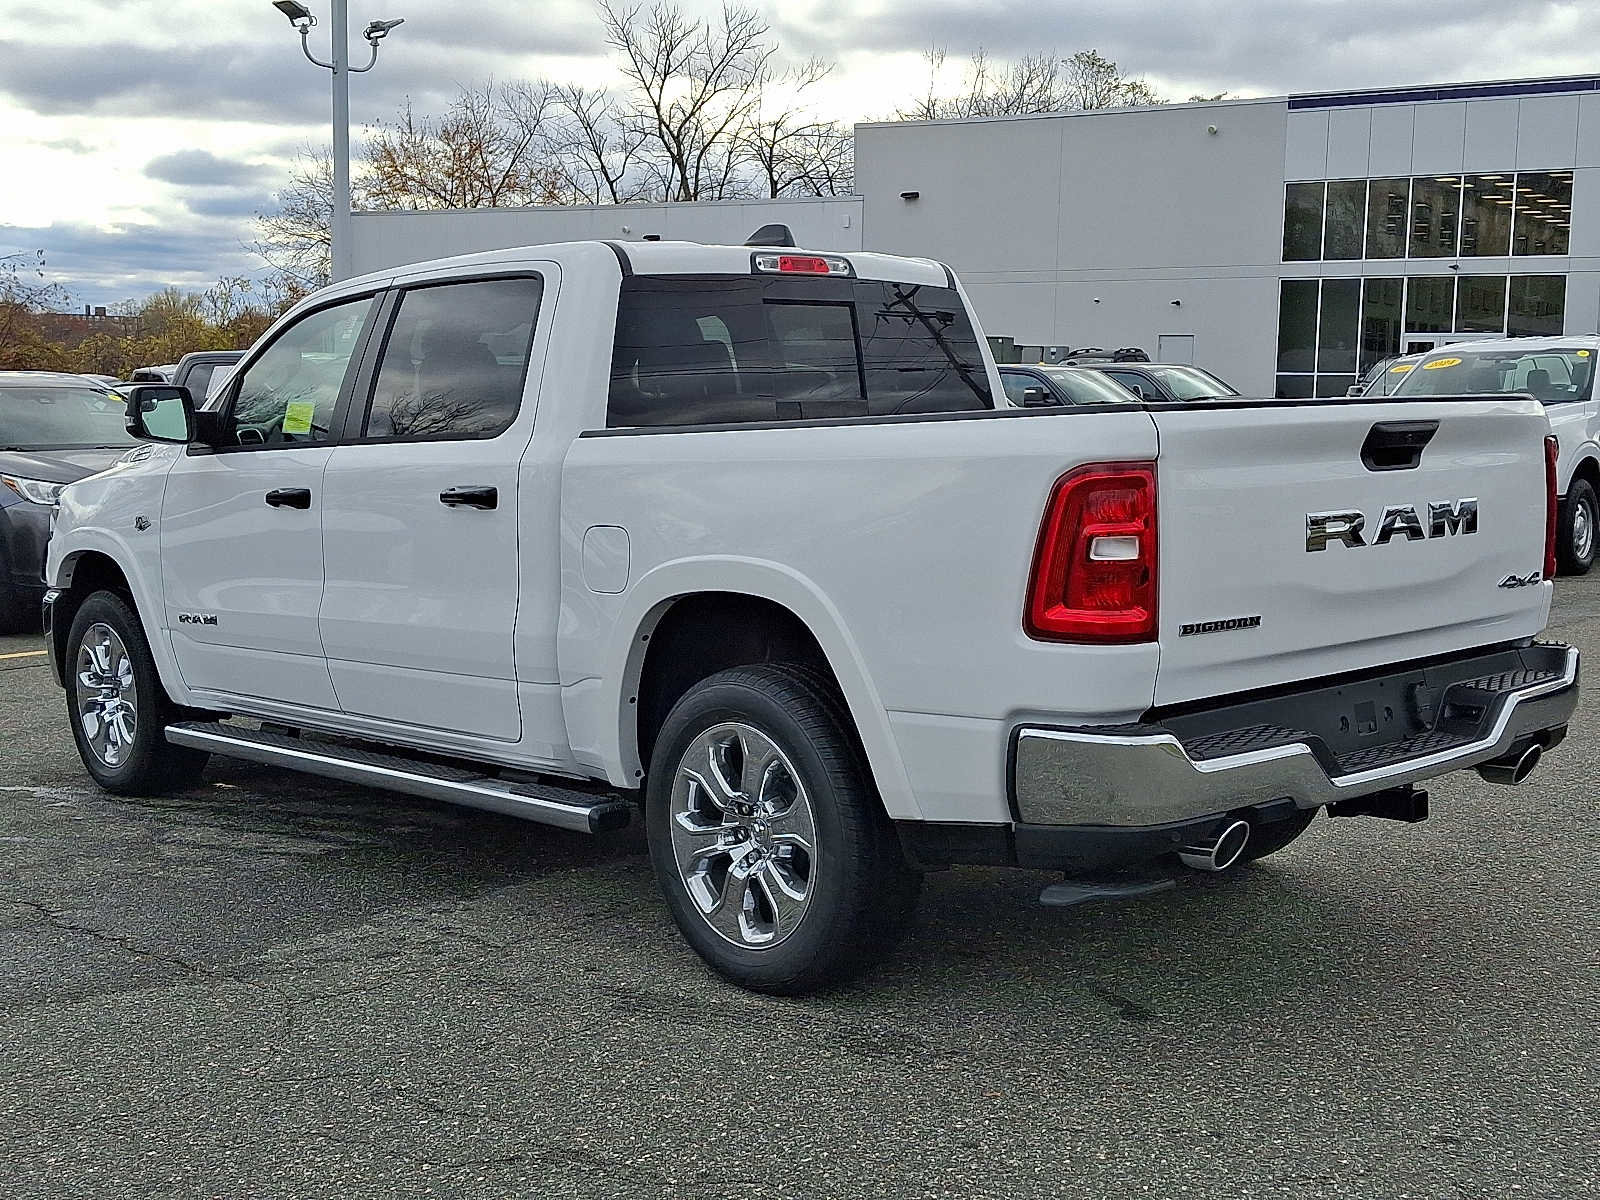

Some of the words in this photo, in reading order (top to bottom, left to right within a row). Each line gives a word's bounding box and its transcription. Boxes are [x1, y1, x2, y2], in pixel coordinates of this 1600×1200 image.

[1305, 497, 1478, 552] RAM
[178, 613, 218, 626] RAM
[1178, 615, 1262, 637] BIGHORN
